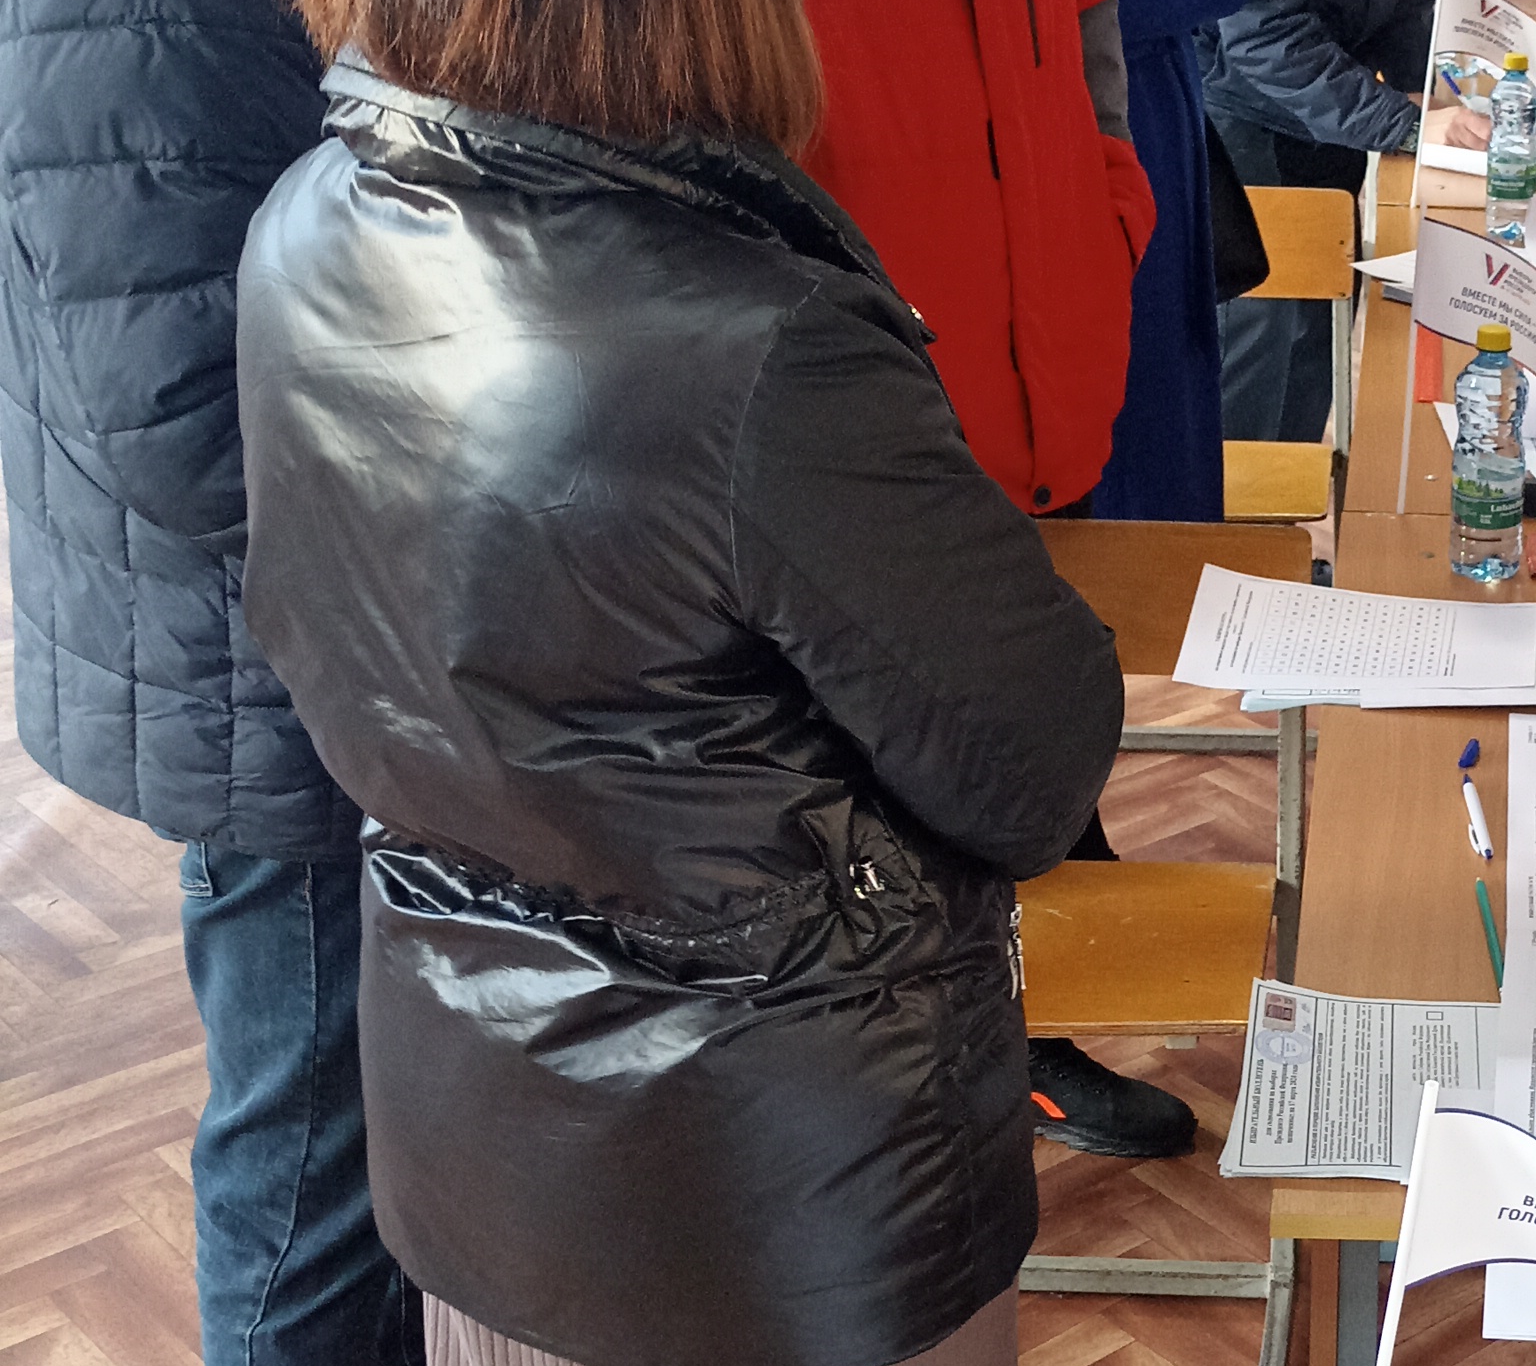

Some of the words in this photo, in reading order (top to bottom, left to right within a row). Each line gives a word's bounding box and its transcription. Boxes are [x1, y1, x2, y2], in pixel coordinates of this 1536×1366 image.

[1449, 297, 1497, 320] ГОЛОСУЕМ
[1499, 315, 1509, 326] ЗА
[1461, 286, 1497, 307] ВМЕСТЕ
[1498, 300, 1512, 314] МЫ
